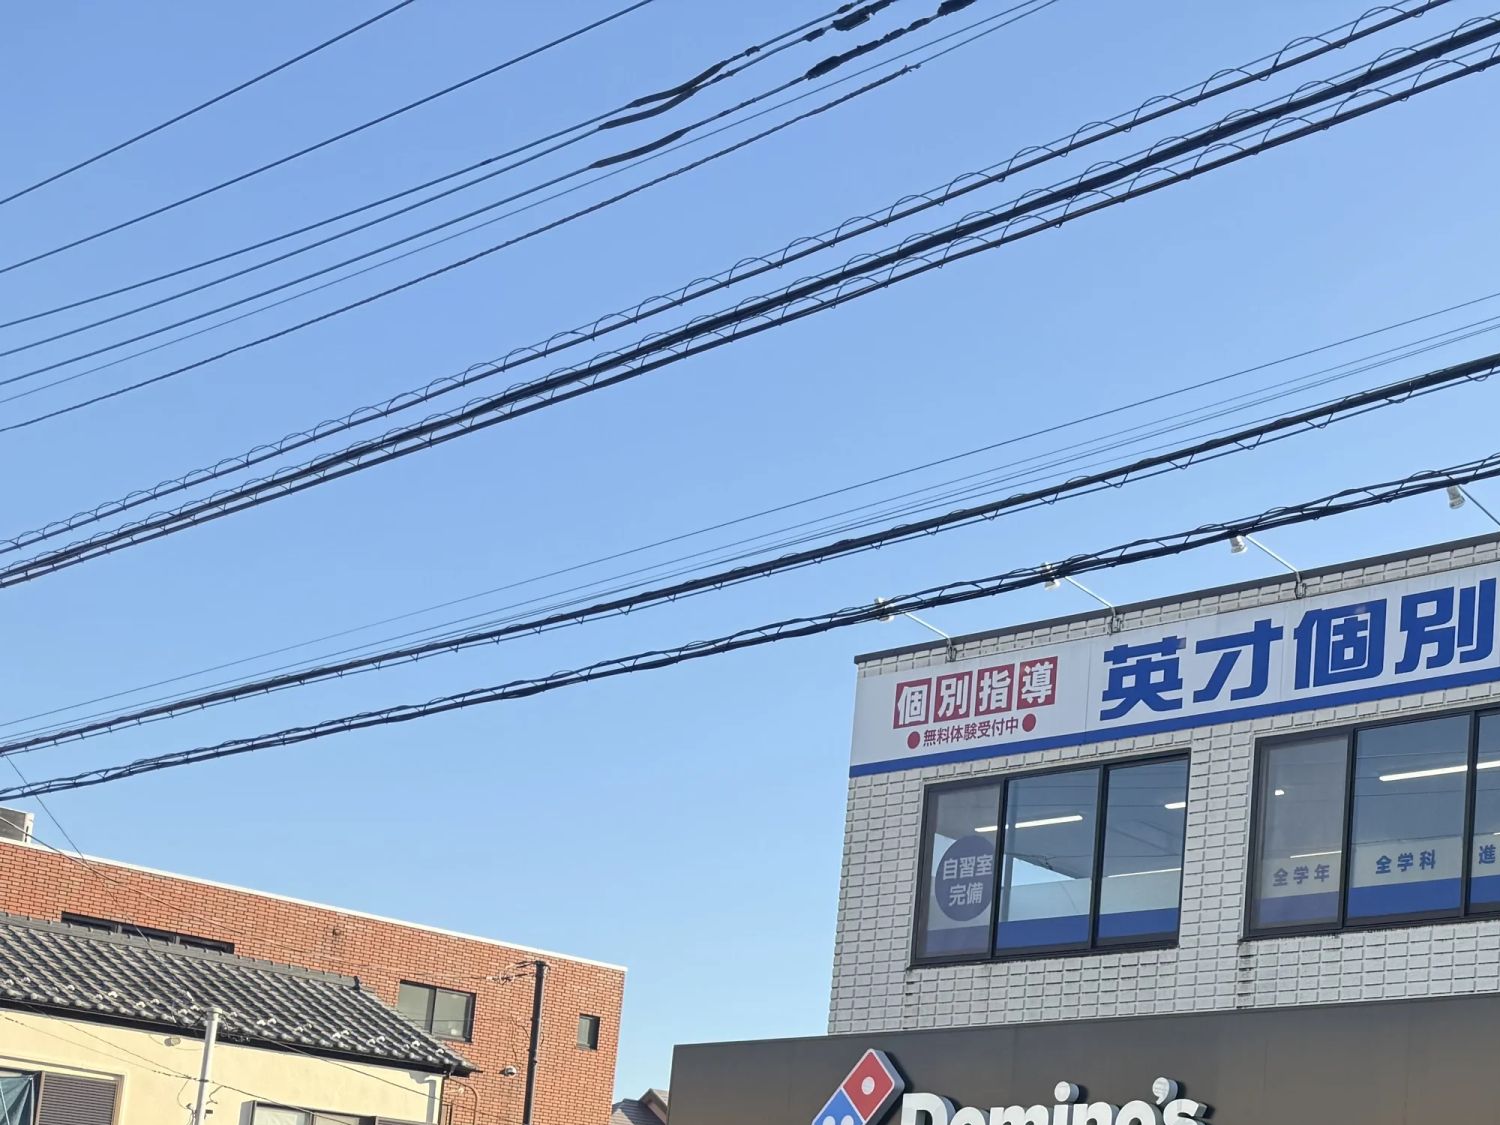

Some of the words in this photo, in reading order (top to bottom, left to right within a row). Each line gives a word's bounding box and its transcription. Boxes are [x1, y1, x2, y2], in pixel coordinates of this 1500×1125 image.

[896, 659, 1056, 727] 個別指導
[922, 717, 1020, 747] 無料体験受付中
[942, 852, 994, 881] 自習室
[1272, 863, 1330, 887] 全学年
[1375, 848, 1437, 876] 全学科
[948, 879, 984, 908] 完備
